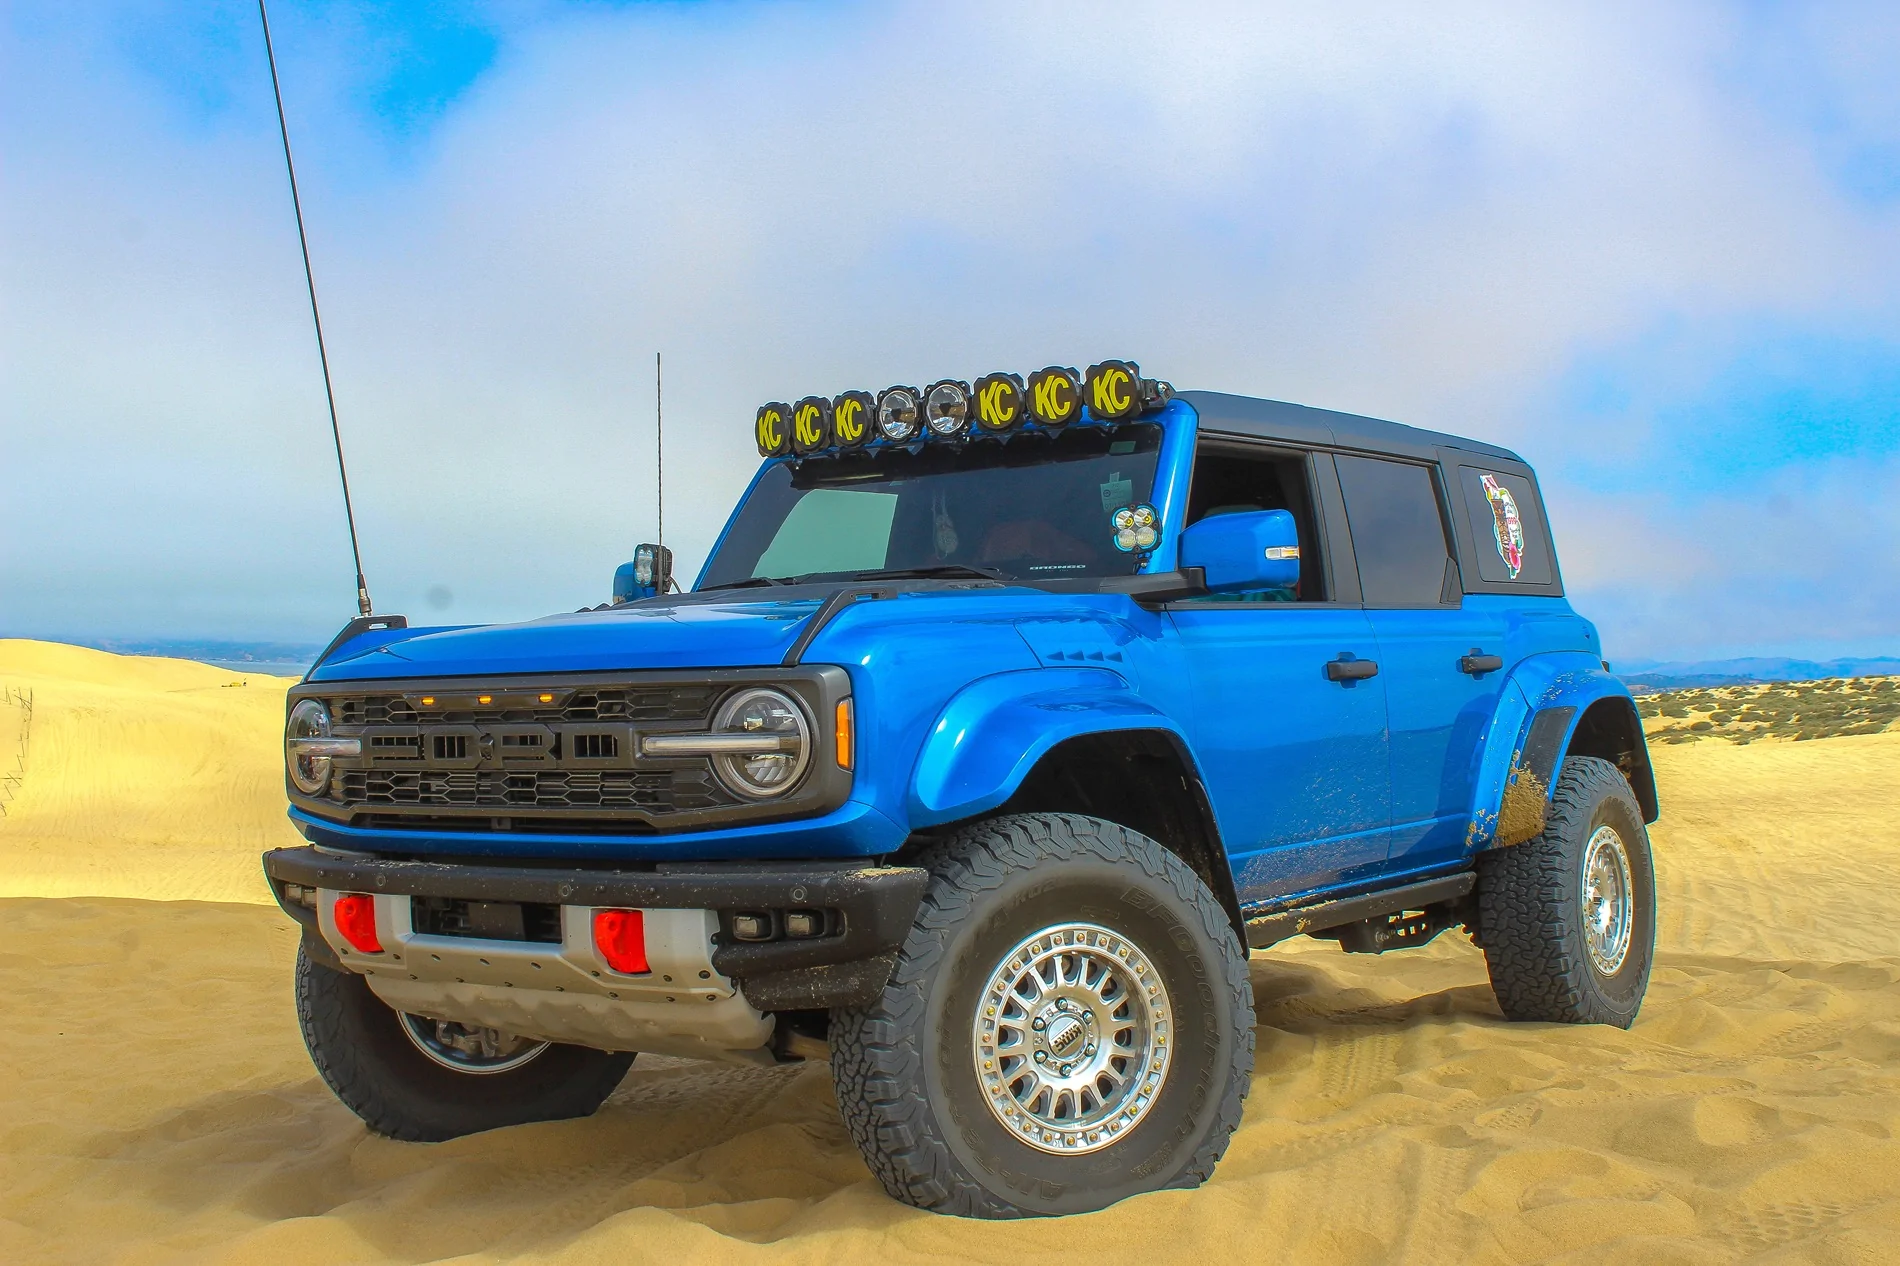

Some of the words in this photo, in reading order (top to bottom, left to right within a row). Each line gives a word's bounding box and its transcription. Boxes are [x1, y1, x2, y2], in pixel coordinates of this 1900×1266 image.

[980, 380, 1014, 426] KC
[1035, 374, 1071, 420] KC
[1093, 368, 1131, 414] KC
[758, 409, 782, 450] KC
[795, 404, 820, 446] KC
[835, 398, 863, 441] KC
[361, 723, 636, 770] FORD
[1120, 885, 1221, 1143] BFGoodrich
[1056, 1026, 1083, 1052] KMC
